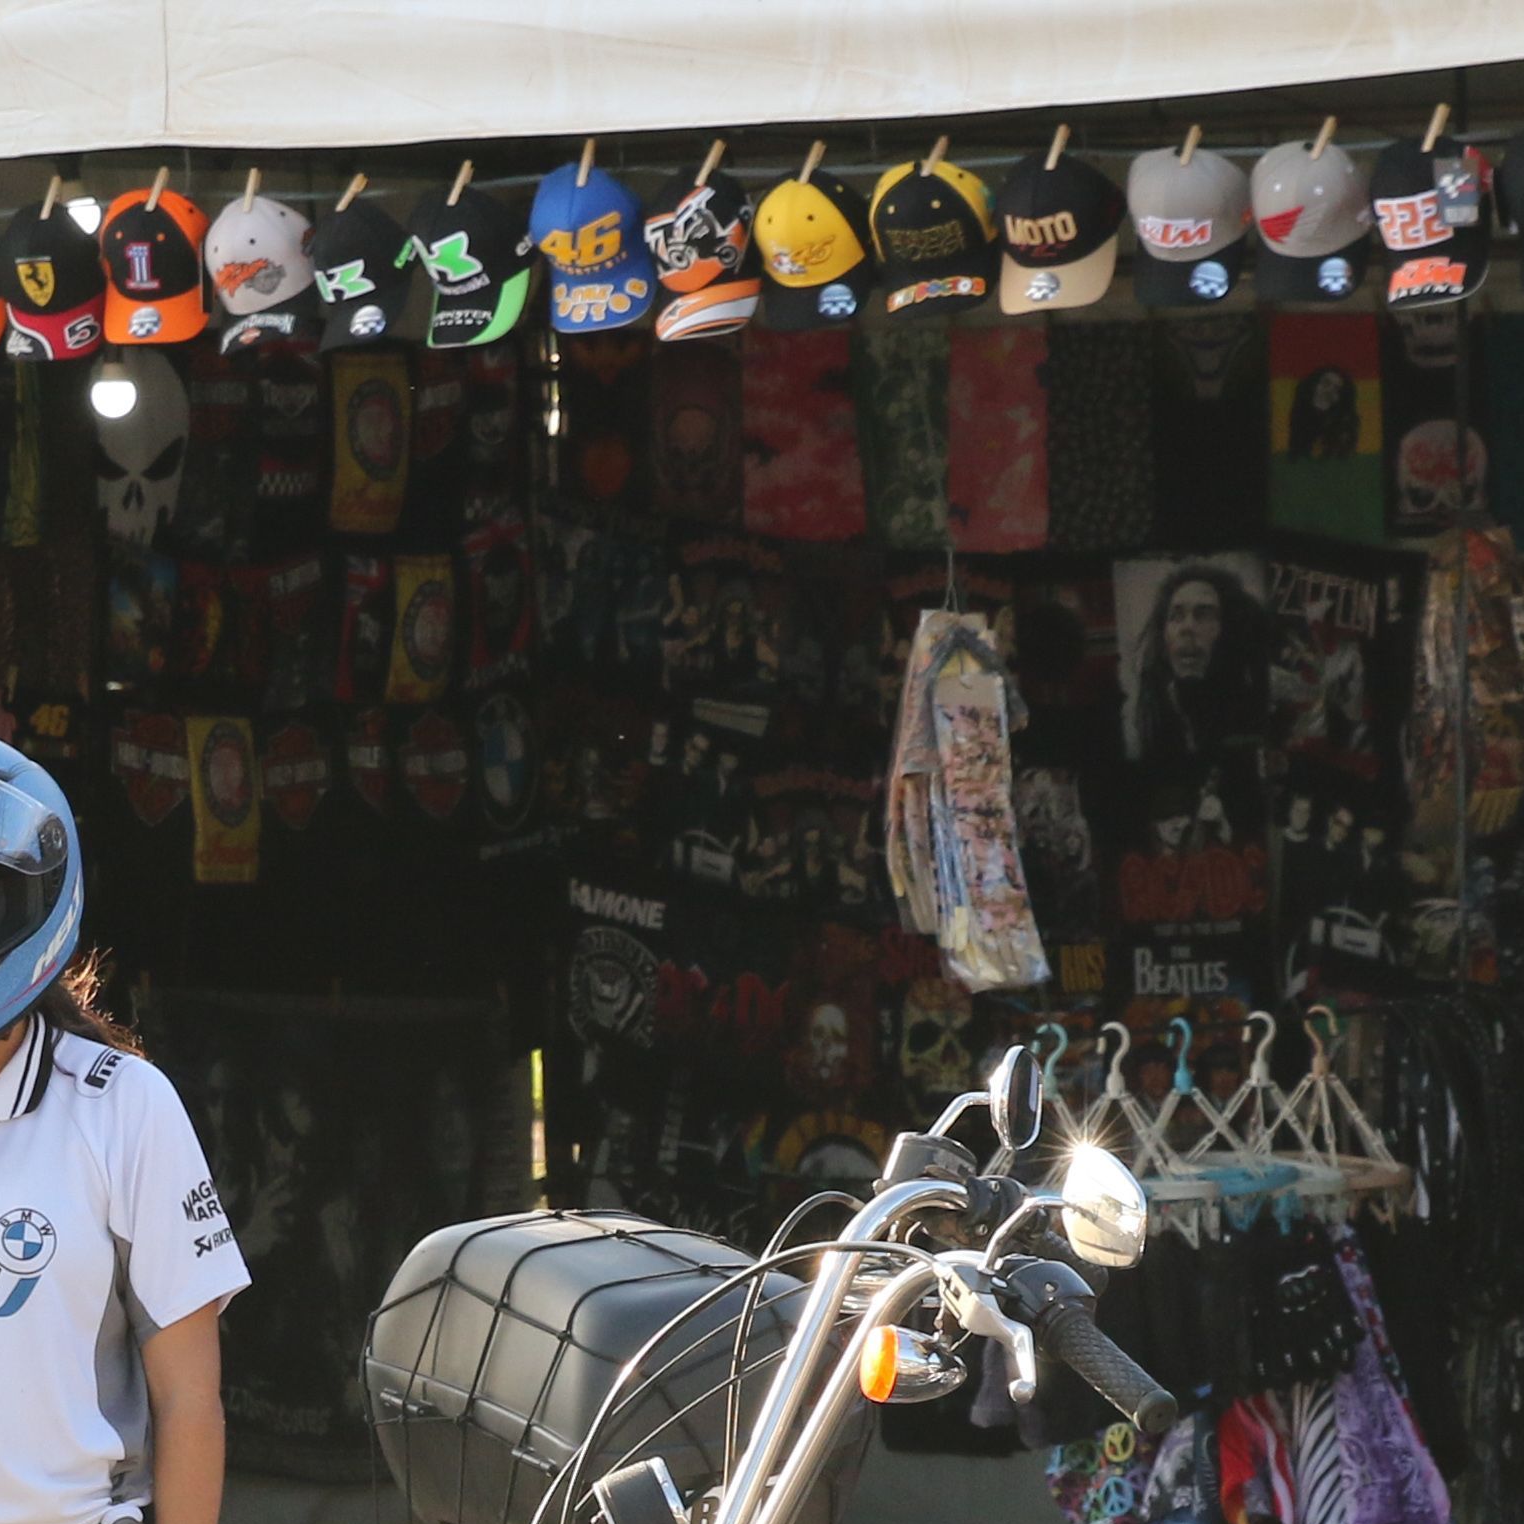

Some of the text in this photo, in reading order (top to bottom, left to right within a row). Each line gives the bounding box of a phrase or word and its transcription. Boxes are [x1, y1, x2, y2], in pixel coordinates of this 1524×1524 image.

[539, 211, 622, 267] 46
[1005, 212, 1077, 246] MOTO
[1133, 948, 1228, 996] BEATLES
[0, 1210, 54, 1238] BMW
